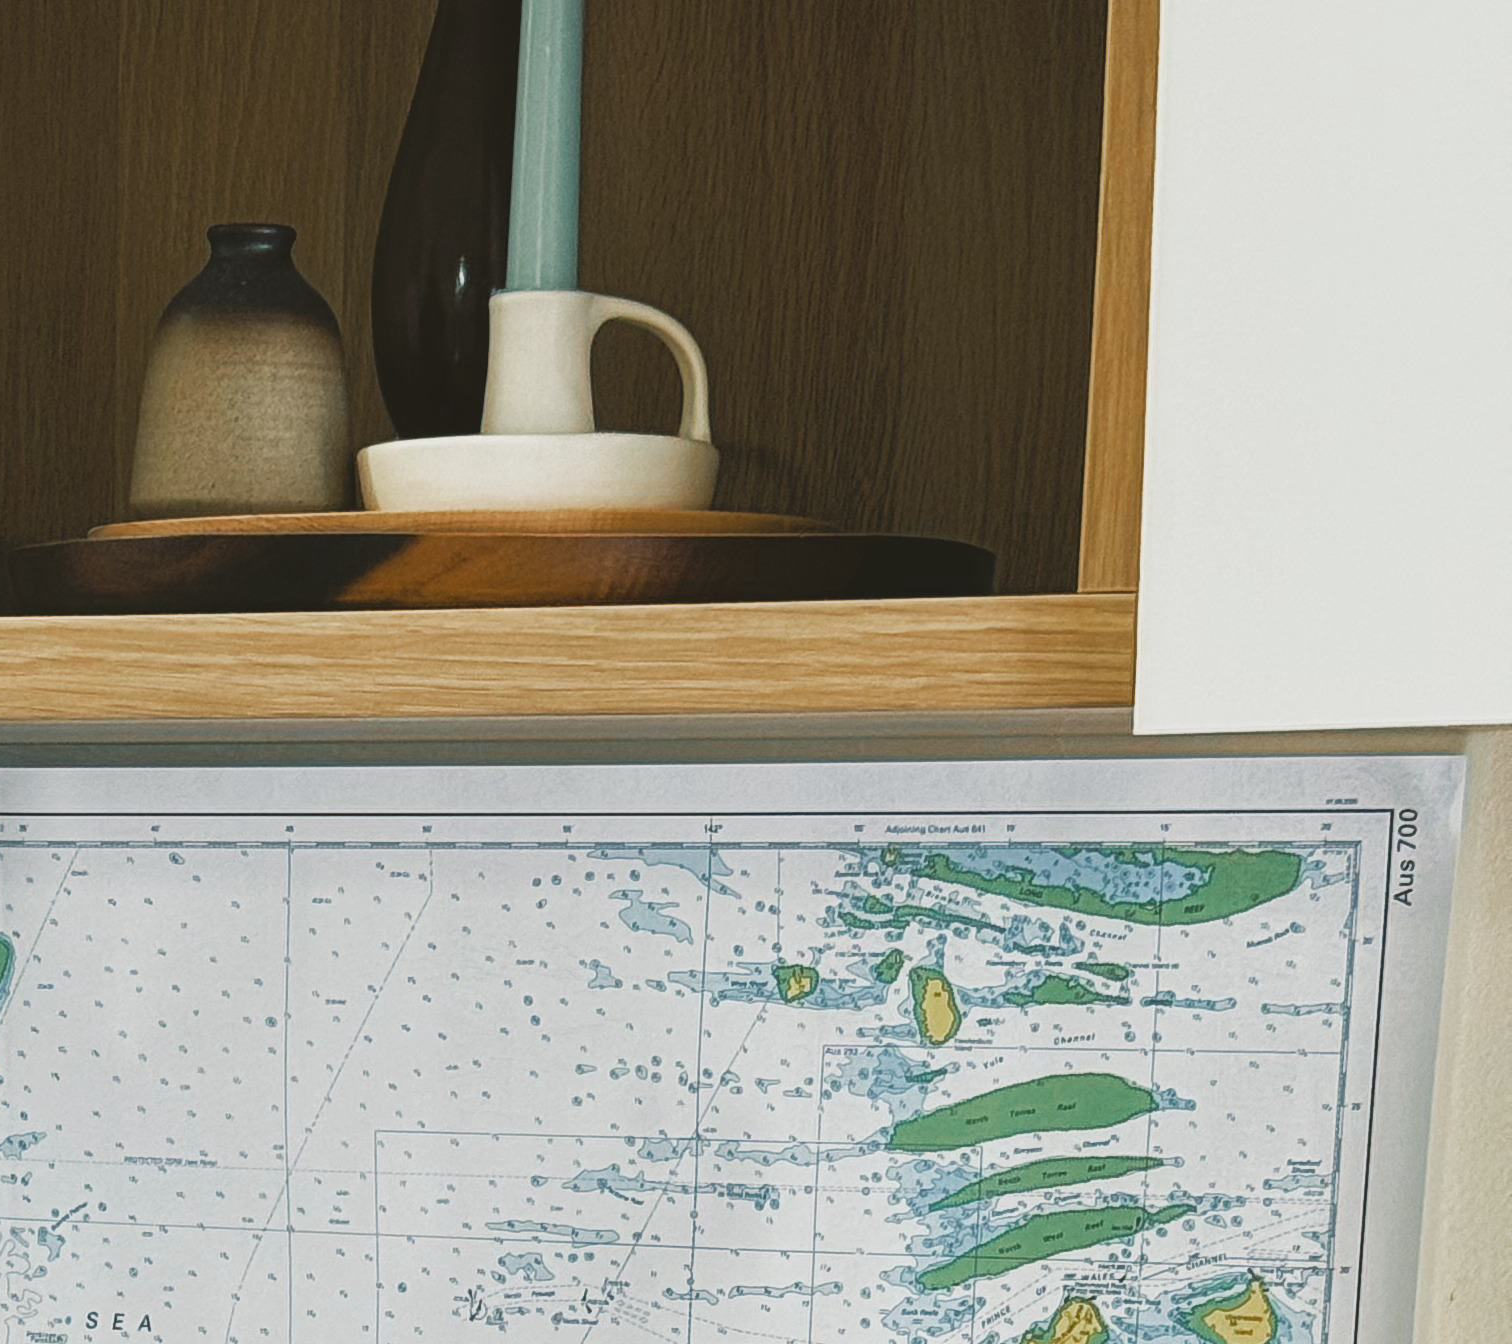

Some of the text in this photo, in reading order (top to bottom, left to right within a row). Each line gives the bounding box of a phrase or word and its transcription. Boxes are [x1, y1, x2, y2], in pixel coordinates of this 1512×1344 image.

[1393, 808, 1418, 907] Aus 700
[85, 1311, 152, 1333] SEA
